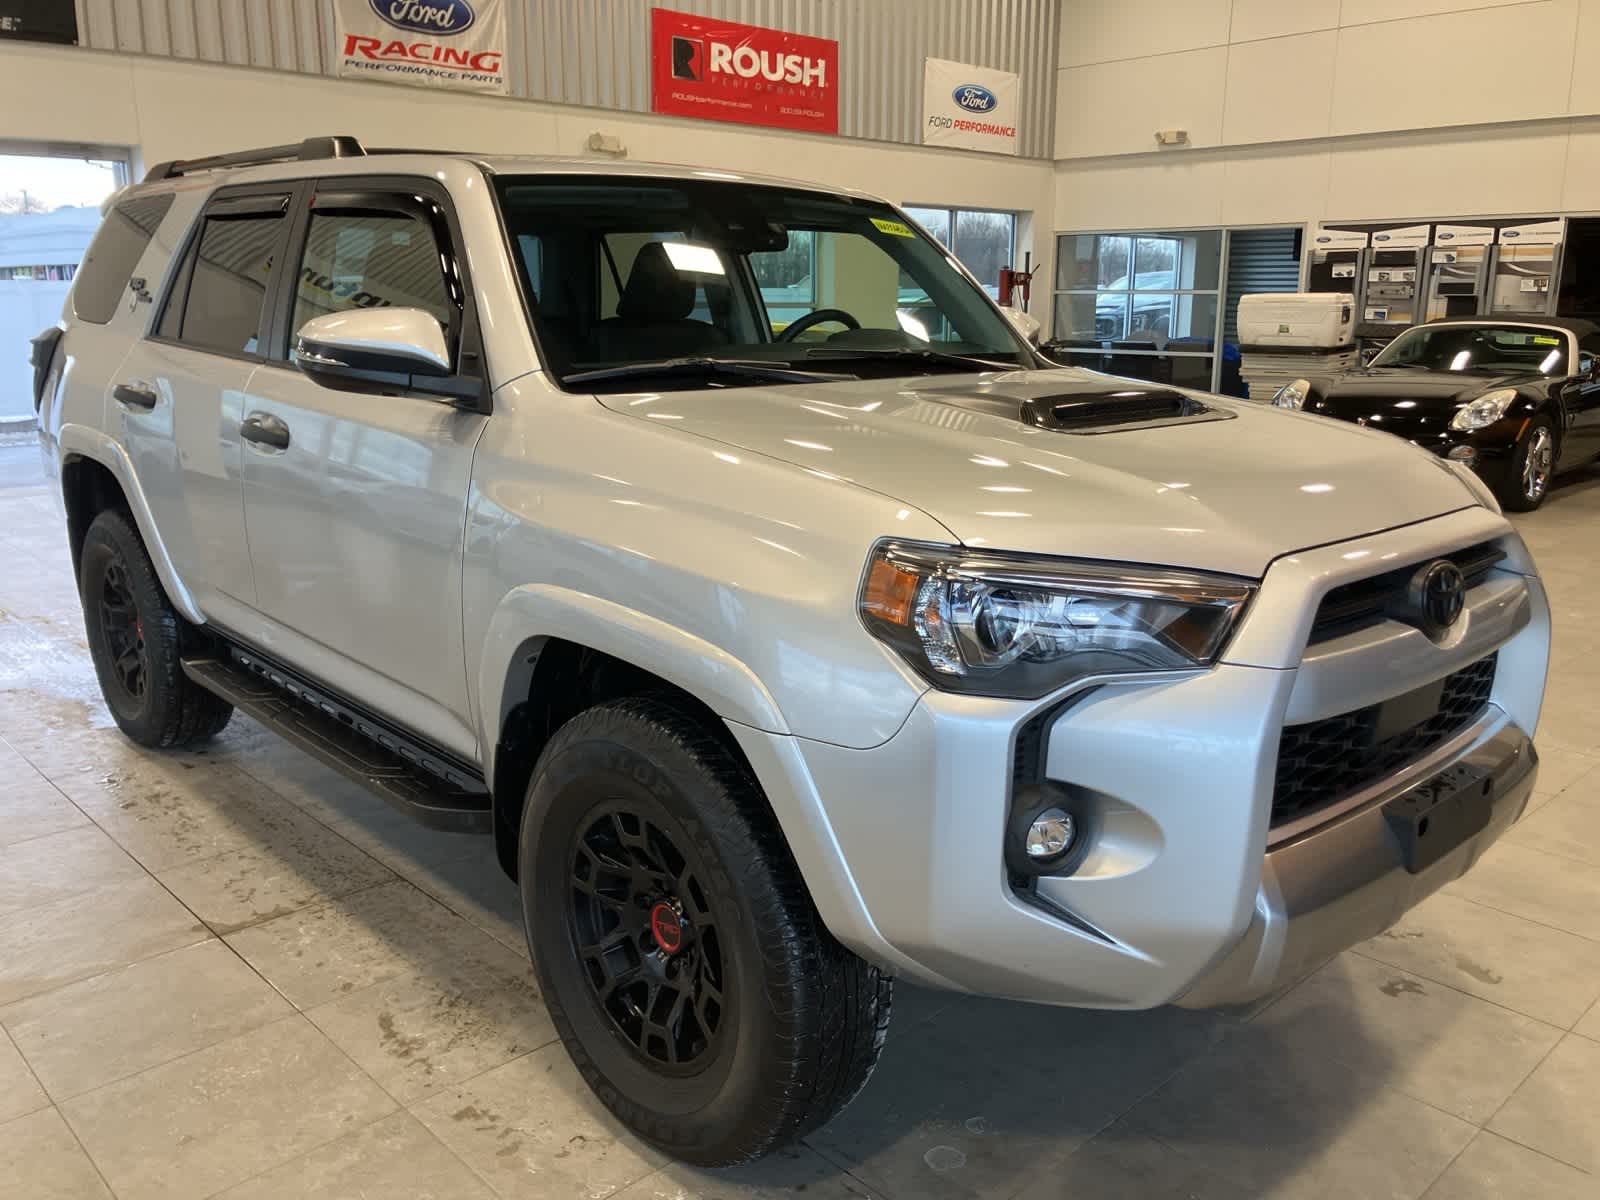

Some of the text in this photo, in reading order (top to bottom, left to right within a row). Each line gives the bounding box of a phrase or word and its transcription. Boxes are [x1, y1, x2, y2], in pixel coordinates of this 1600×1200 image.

[389, 0, 455, 28] Ford
[344, 34, 502, 73] RACING
[710, 42, 826, 88] ROUSH
[345, 59, 503, 84] PERFORMANCE PARTS
[961, 88, 989, 109] Ford
[928, 115, 1017, 138] FORD PERFORMANCE
